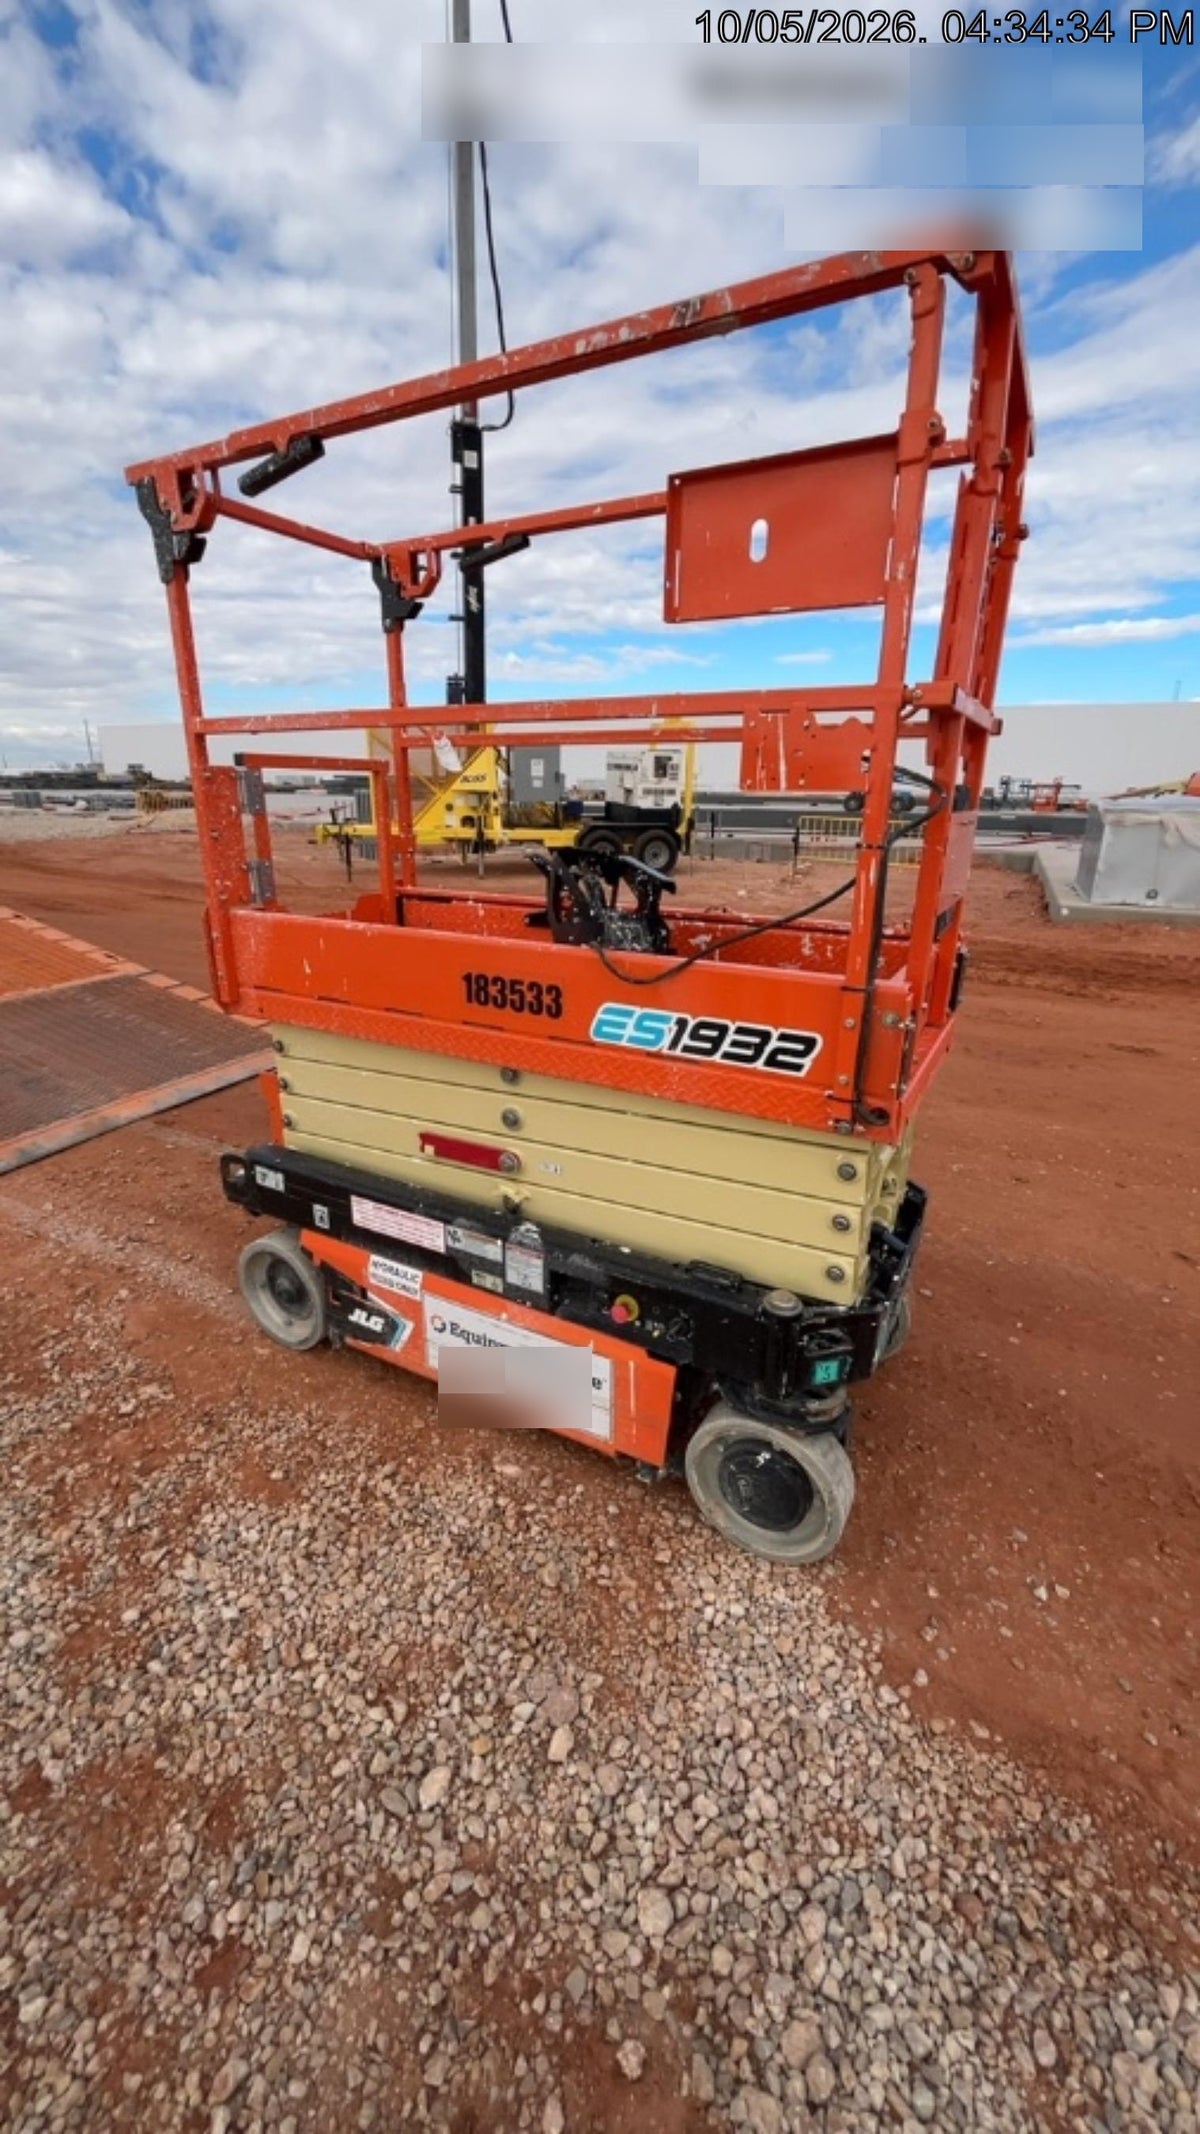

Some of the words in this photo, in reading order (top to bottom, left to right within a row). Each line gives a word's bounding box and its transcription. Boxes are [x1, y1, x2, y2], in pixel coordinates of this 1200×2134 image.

[462, 971, 563, 1020] 183533
[591, 1004, 821, 1074] ES1932
[347, 1307, 385, 1333] JLG
